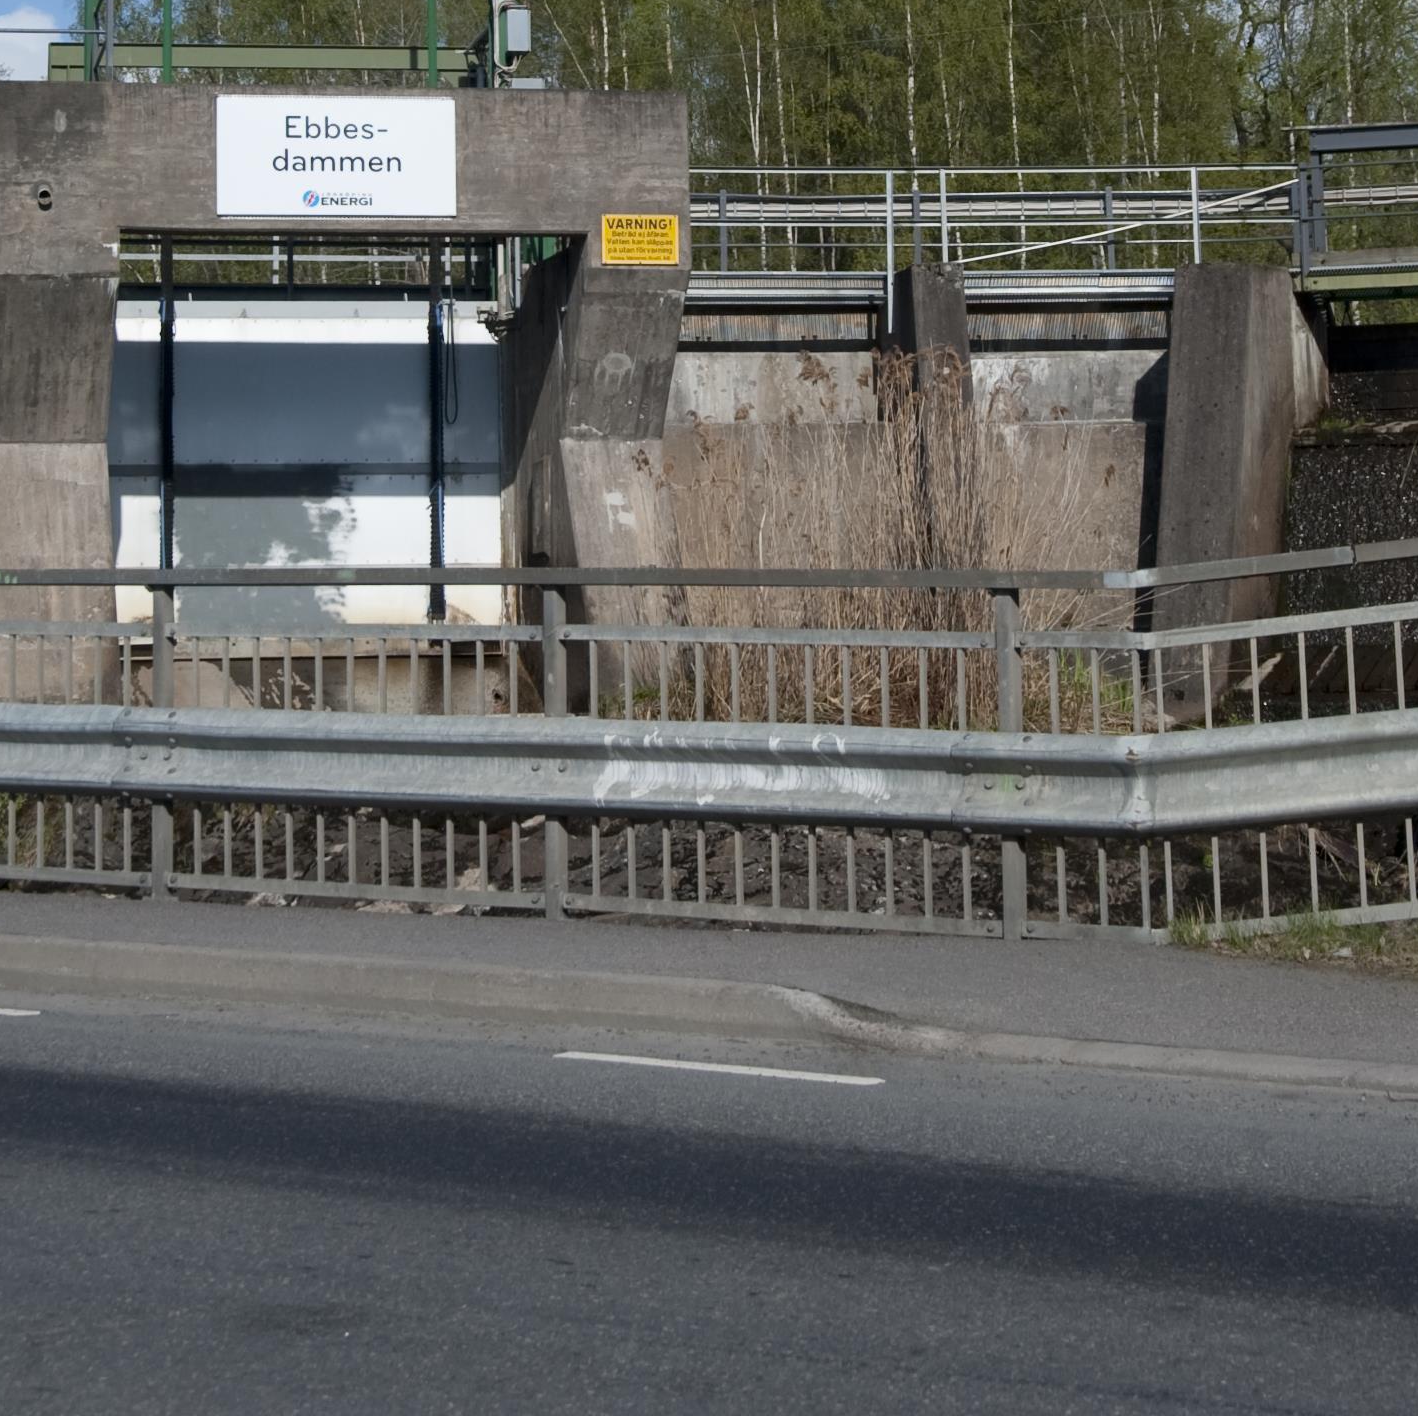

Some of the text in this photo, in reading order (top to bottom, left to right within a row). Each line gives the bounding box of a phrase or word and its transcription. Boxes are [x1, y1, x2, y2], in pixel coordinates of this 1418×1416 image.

[285, 115, 389, 140] Ebbes-
[272, 148, 402, 172] dammen
[321, 197, 373, 206] ENERGI
[606, 218, 672, 230] VARNING!
